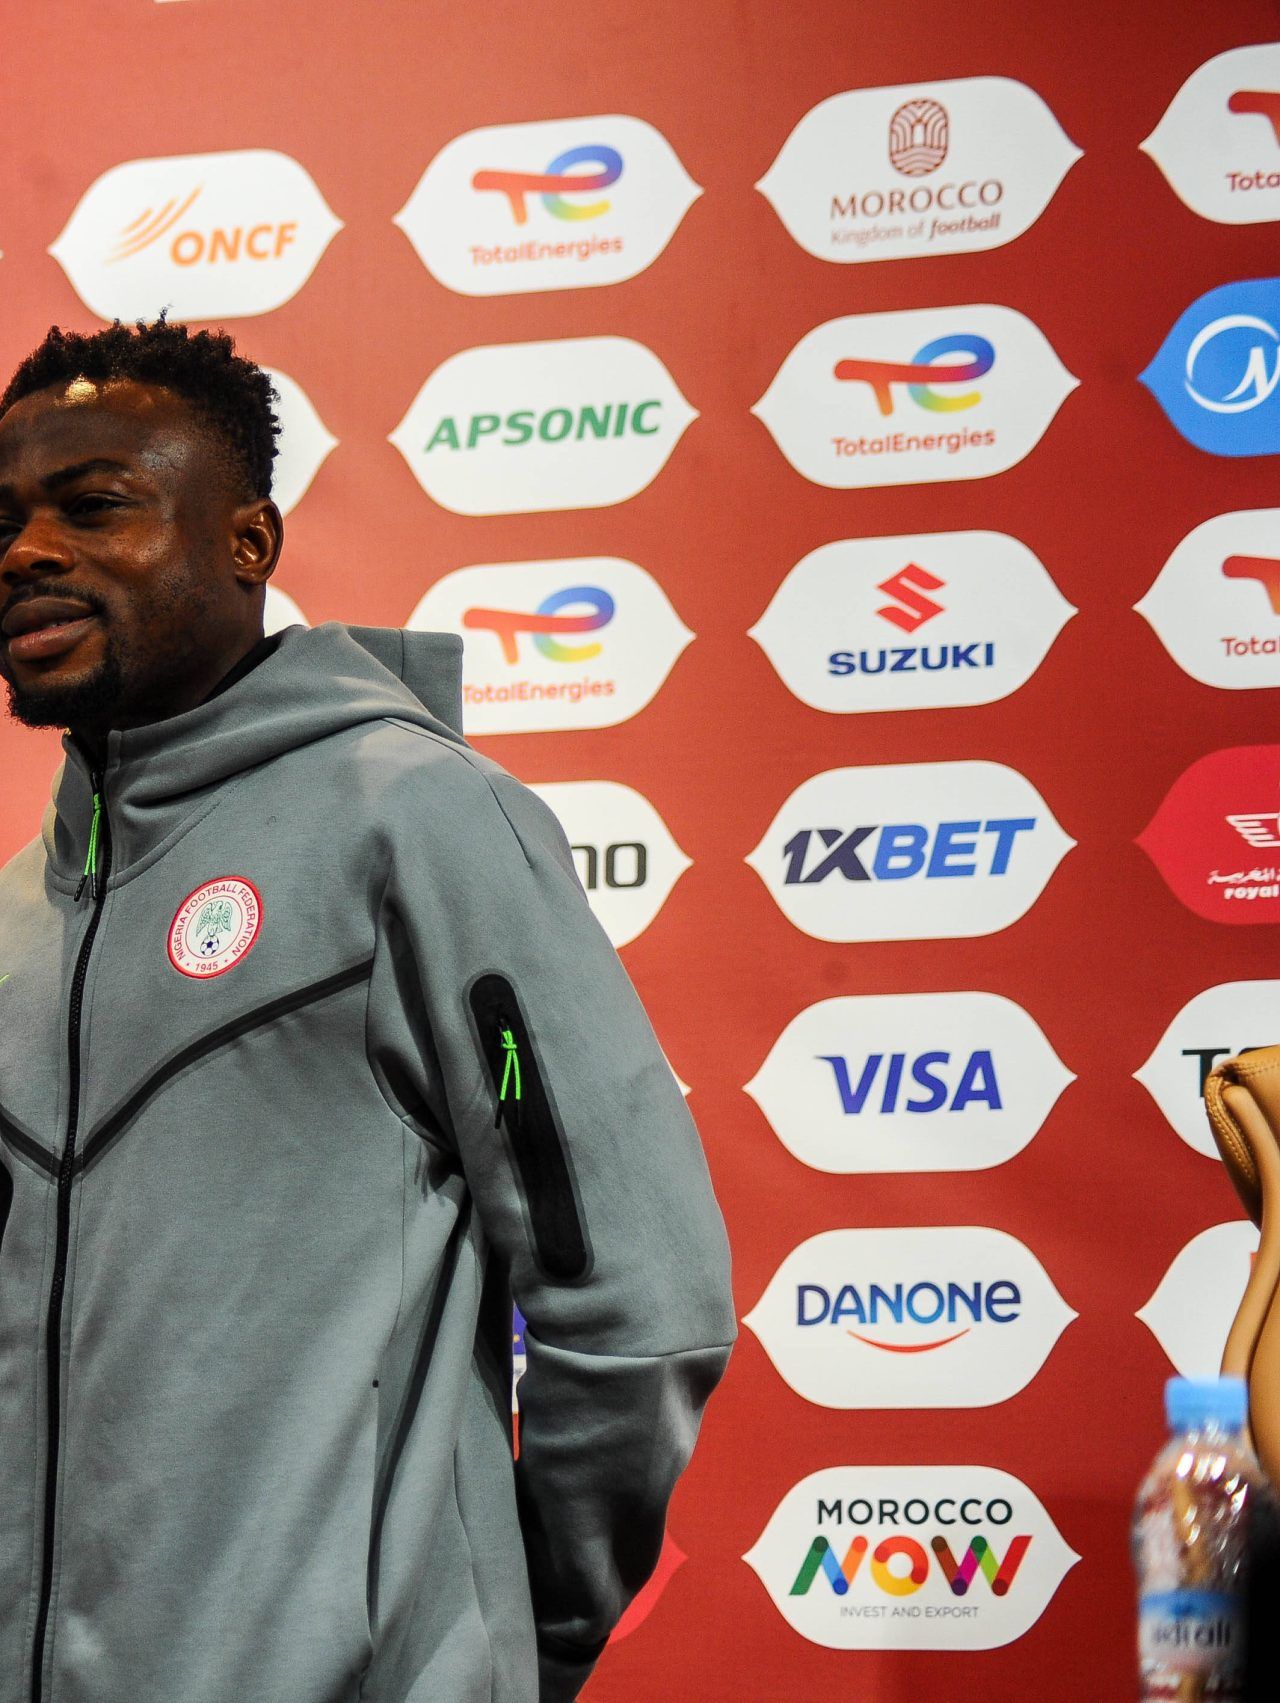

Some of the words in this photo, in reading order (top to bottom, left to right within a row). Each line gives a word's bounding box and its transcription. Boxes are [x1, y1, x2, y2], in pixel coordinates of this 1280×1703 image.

[831, 179, 1003, 219] MOROCCO
[169, 221, 297, 267] ONCF
[831, 225, 903, 247] Kingdom
[907, 221, 924, 236] of
[928, 212, 1002, 241] football
[469, 235, 624, 267] TotalEnergies
[424, 400, 662, 453] APSONIC
[831, 428, 995, 458] TotalEnergies
[828, 642, 995, 677] SUZUKI
[463, 677, 616, 705] TotalEnergies
[782, 817, 1036, 885] 1XBET
[1224, 884, 1280, 900] royal
[174, 915, 187, 961] NIGERIA
[185, 884, 237, 915] FOOTBALL
[232, 888, 256, 956] FEDERATION
[195, 961, 218, 972] 1945
[814, 1049, 1003, 1115] VISA
[817, 1498, 1013, 1526] MOROCCO
[788, 1535, 1033, 1597] NOW
[839, 1606, 888, 1618] INVEST
[891, 1606, 921, 1618] AND
[924, 1606, 979, 1618] EXPORT
